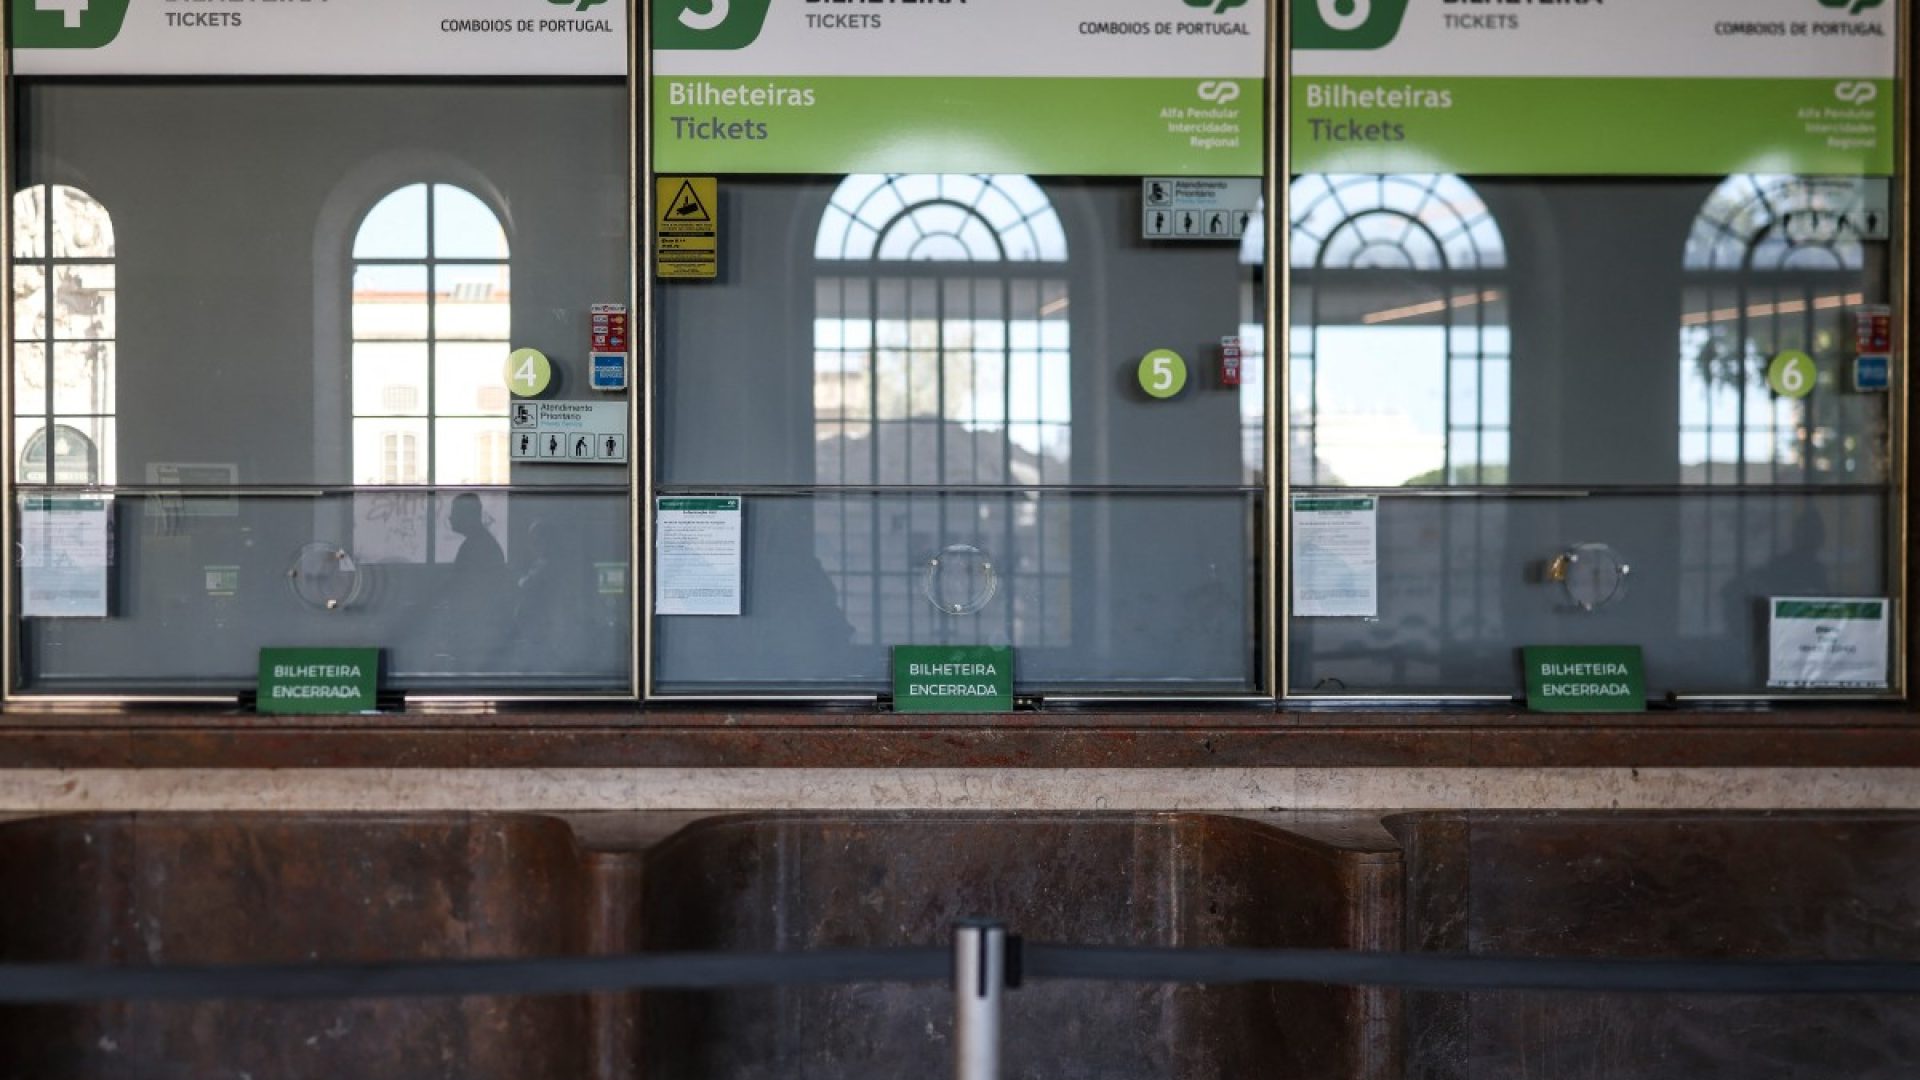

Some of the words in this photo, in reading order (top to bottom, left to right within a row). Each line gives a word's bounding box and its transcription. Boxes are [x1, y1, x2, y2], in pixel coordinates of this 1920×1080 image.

[165, 12, 242, 27] TICKETS
[440, 18, 512, 32] COMBOIOS
[516, 18, 534, 32] DE
[539, 18, 613, 32] PORTUGAL
[805, 13, 882, 28] TICKETS
[1444, 13, 1519, 29] TICKETS
[1079, 21, 1150, 35] COMBOIOS
[1154, 21, 1172, 35] DE
[1176, 21, 1250, 35] PORTUGAL
[1714, 21, 1786, 36] COMBOIOS
[1790, 21, 1808, 36] DE
[1812, 21, 1885, 36] PORTUGAL
[669, 82, 816, 106] Bilheteiras
[1306, 83, 1453, 108] Bilheteiras
[1160, 107, 1184, 118] Alfa
[1187, 107, 1239, 118] Pendular
[670, 115, 769, 140] Tickets
[1167, 122, 1240, 133] Intercidades
[1307, 117, 1406, 142] Tickets
[1190, 136, 1239, 149] Regional
[514, 355, 537, 387] 4
[1152, 357, 1172, 390] 5
[1782, 357, 1803, 391] 6
[540, 403, 593, 412] Atendimento
[273, 664, 362, 678] BILHETEIRA
[909, 663, 997, 676] BILHETEIRA
[1541, 663, 1629, 676] BILHETEIRA
[271, 685, 362, 698] ENCERRADA
[909, 684, 998, 696] ENCERRADA
[1542, 684, 1631, 696] ENCERRADA
